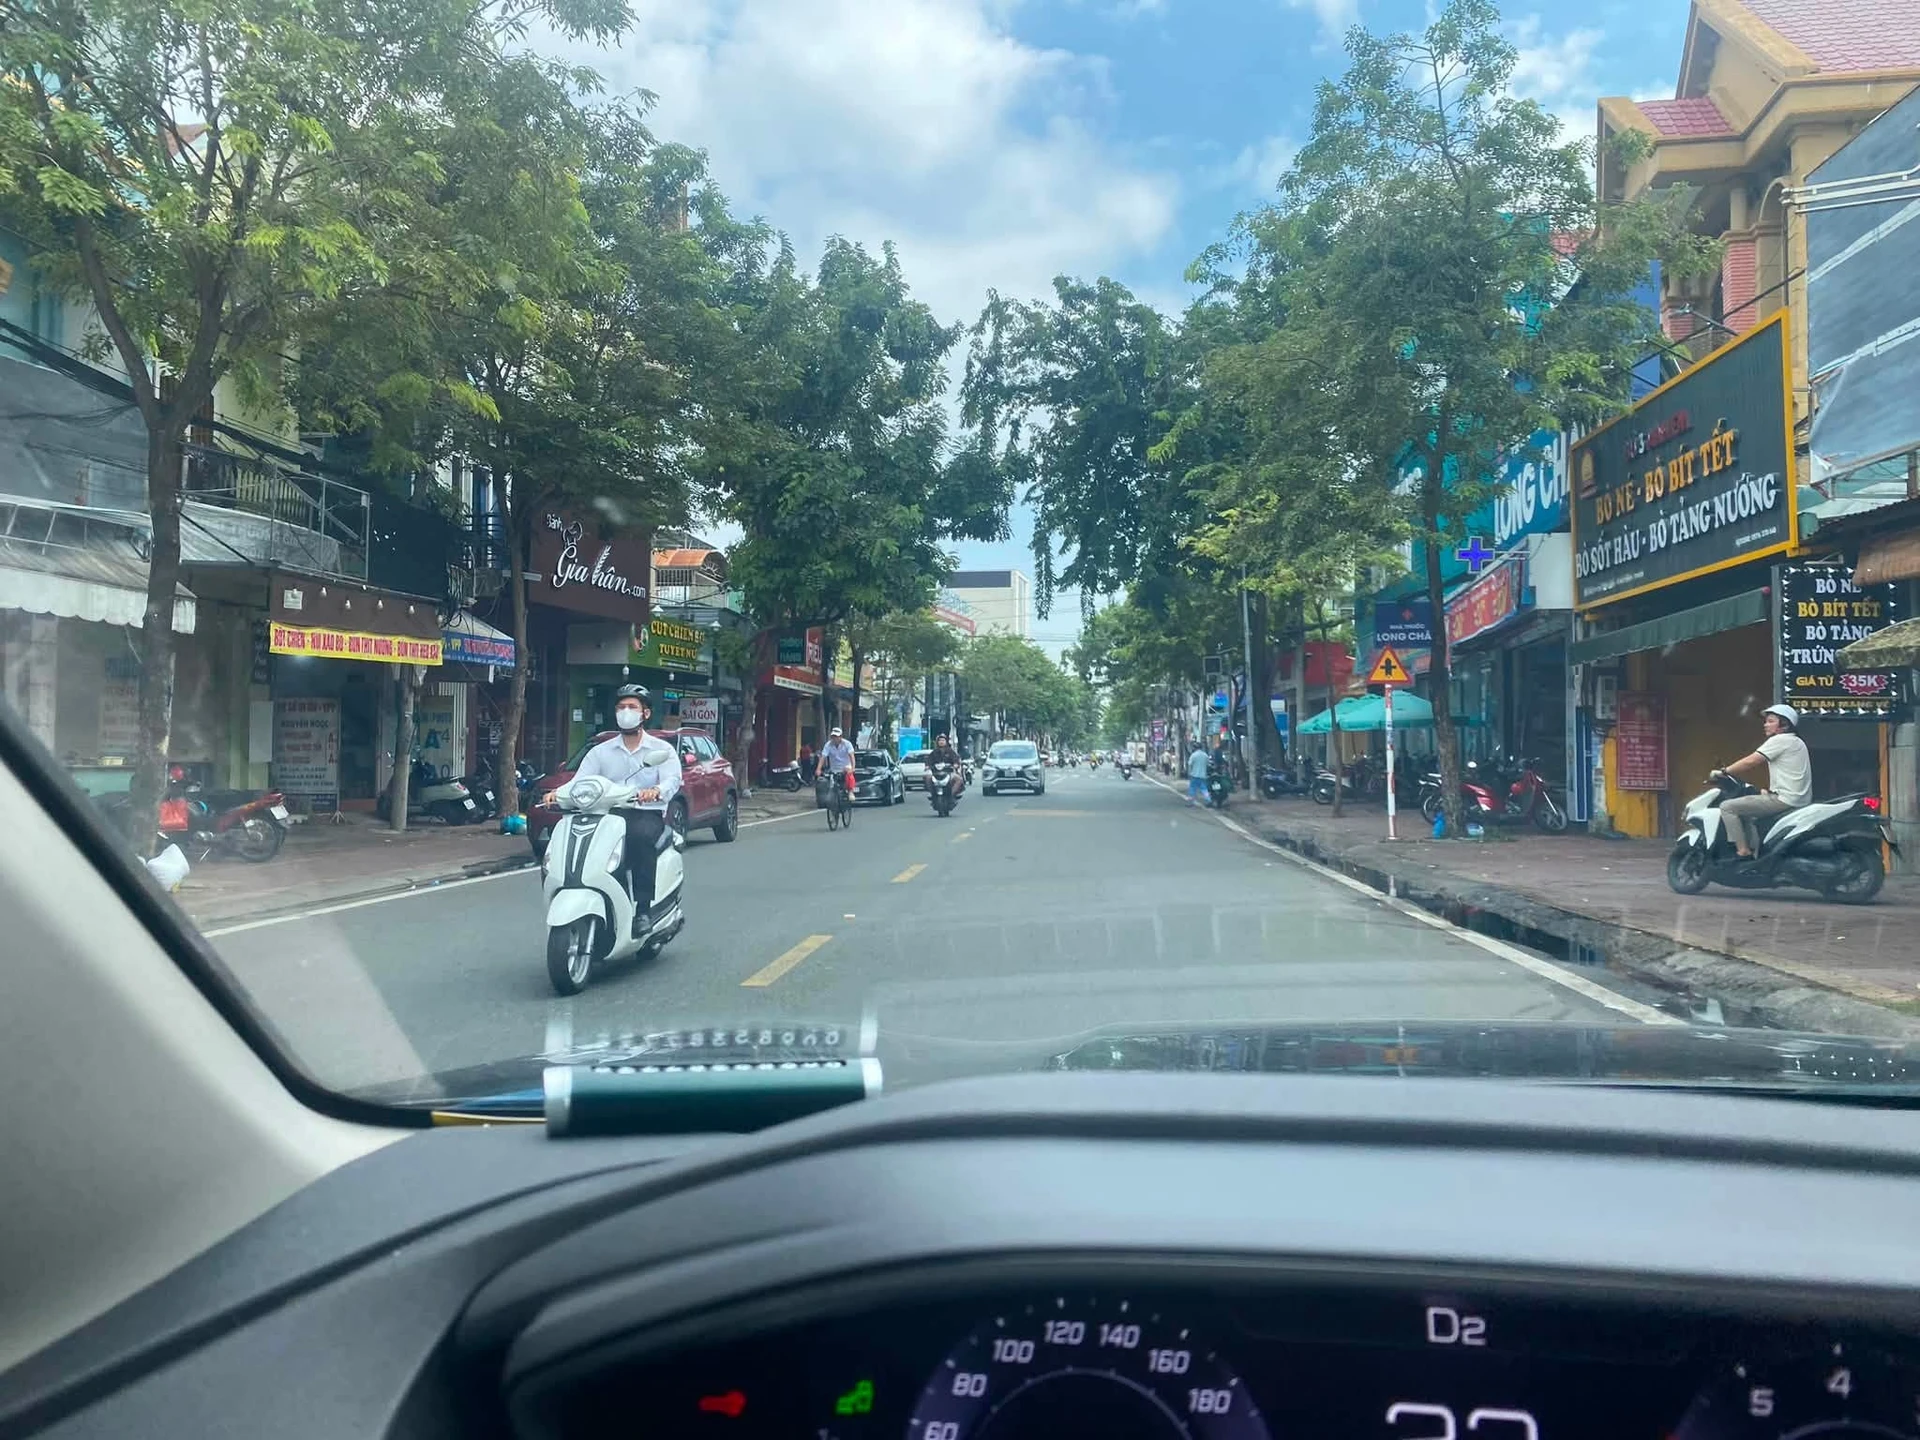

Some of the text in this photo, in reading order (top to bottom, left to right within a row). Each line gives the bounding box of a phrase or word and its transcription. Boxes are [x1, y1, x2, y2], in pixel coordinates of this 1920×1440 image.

[1596, 483, 1612, 525] BÒ
[1616, 472, 1635, 517] NÉ
[1644, 456, 1665, 503] BÒ
[1668, 443, 1695, 492] BÍT
[1700, 417, 1736, 476] TẾT
[1575, 541, 1589, 578] BÒ
[1590, 531, 1611, 573] SỐT
[1614, 525, 1640, 565] HÀU
[1649, 510, 1667, 553] BÒ
[1670, 496, 1711, 545] TẢNG
[1714, 472, 1778, 529] NƯỚNG
[553, 545, 589, 588] Gia
[1816, 574, 1836, 593] BÒ
[1798, 596, 1880, 617] BÒ BÍT TẾT
[1376, 633, 1406, 641] LONG
[1805, 621, 1827, 640] BÒ
[1848, 674, 1879, 687] 35K
[1044, 1320, 1085, 1345] 120
[1100, 1324, 1140, 1349] 140
[992, 1339, 1035, 1364] 100
[1148, 1349, 1191, 1375] 160
[952, 1372, 987, 1398] 80
[1827, 1369, 1852, 1399] 4
[1188, 1387, 1232, 1415] 180
[1749, 1388, 1774, 1417] 5
[924, 1421, 959, 1440] 60
